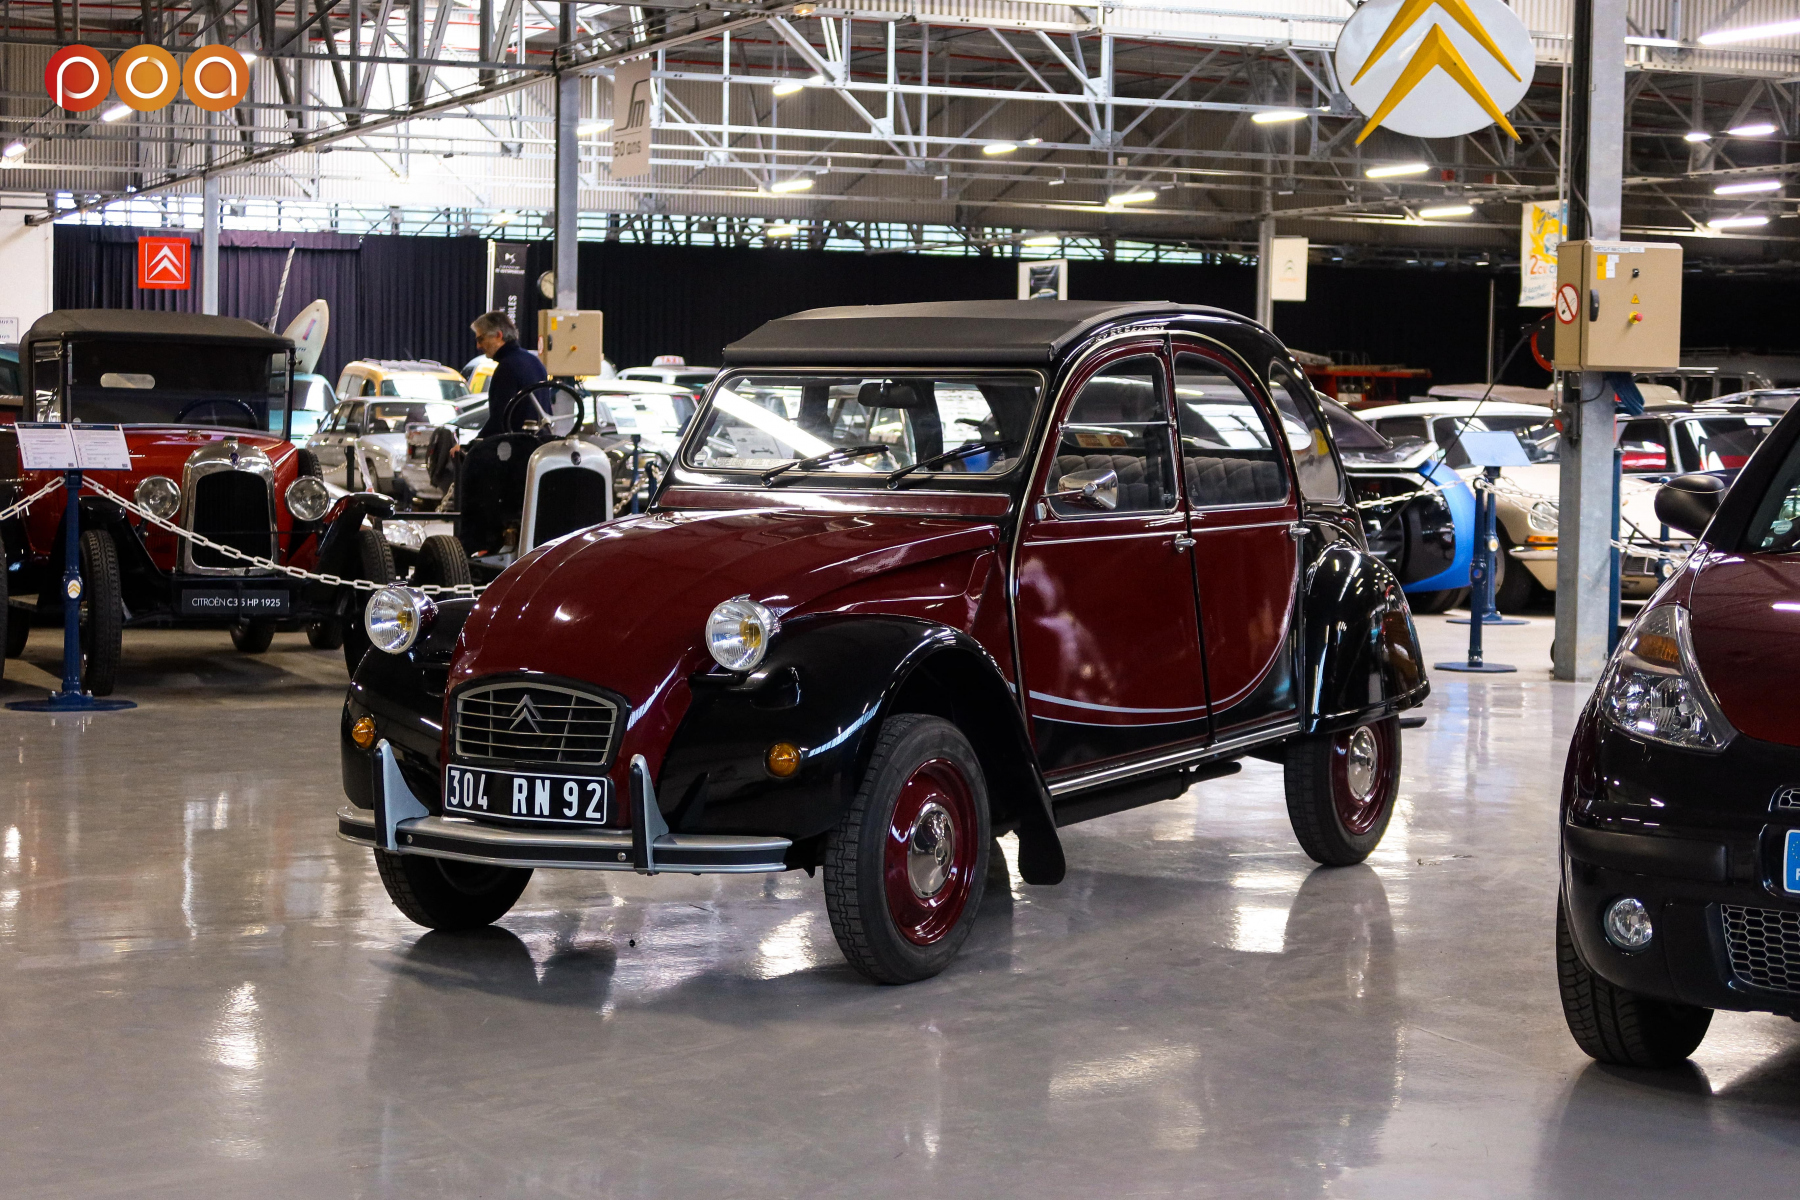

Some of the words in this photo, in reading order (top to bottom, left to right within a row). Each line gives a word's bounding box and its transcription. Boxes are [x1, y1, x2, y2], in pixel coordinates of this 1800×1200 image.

[660, 356, 682, 364] TAXI
[226, 598, 239, 607] C3
[247, 598, 259, 607] HP
[261, 598, 281, 607] 1925
[450, 770, 488, 810] 304
[512, 777, 551, 816] RN
[563, 781, 602, 819] 92
